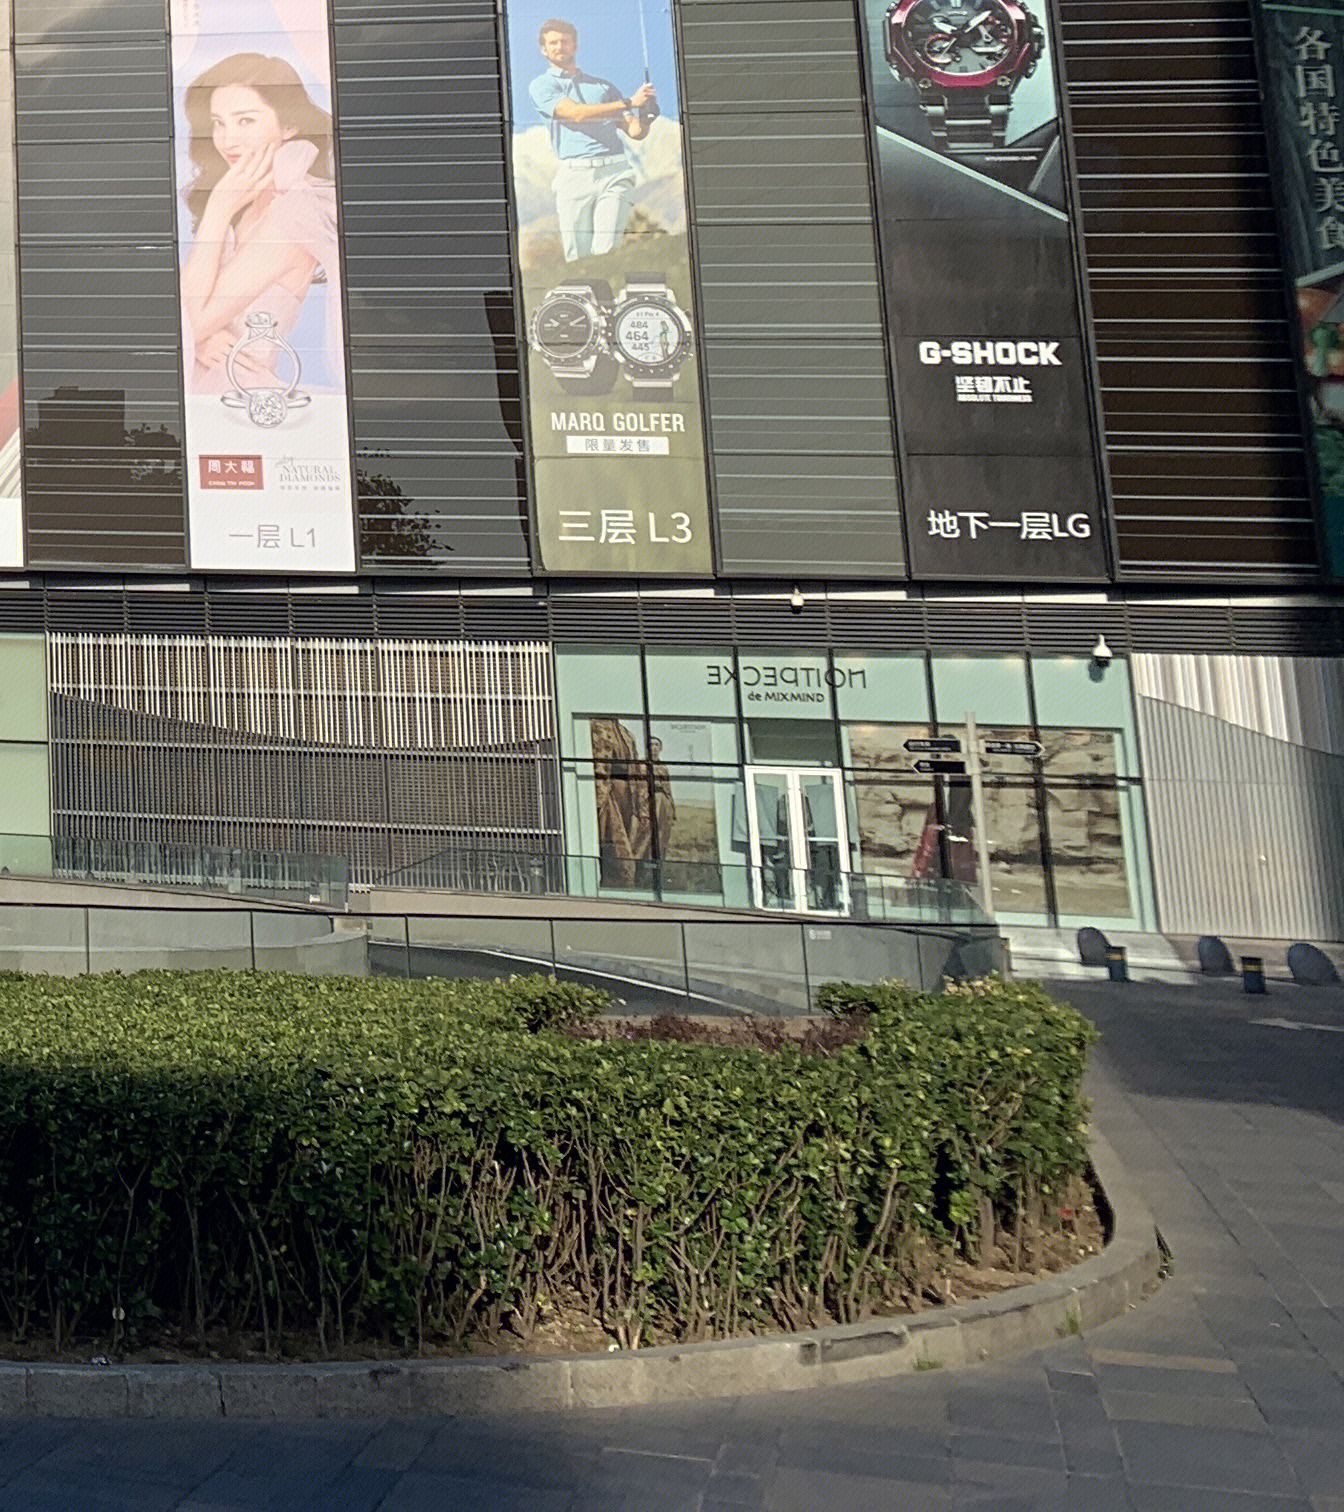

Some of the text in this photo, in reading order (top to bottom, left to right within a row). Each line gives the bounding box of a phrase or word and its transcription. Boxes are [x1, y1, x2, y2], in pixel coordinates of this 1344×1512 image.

[625, 331, 650, 341] 464
[919, 341, 1062, 366] G-SHOCK
[551, 412, 685, 433] MARQ GOLFER
[585, 438, 651, 453] 限量发售
[208, 460, 255, 473] 周大福
[558, 509, 693, 545] 三层 L3
[229, 524, 316, 549] 一层 L1
[748, 691, 825, 702] de MIXMIND
